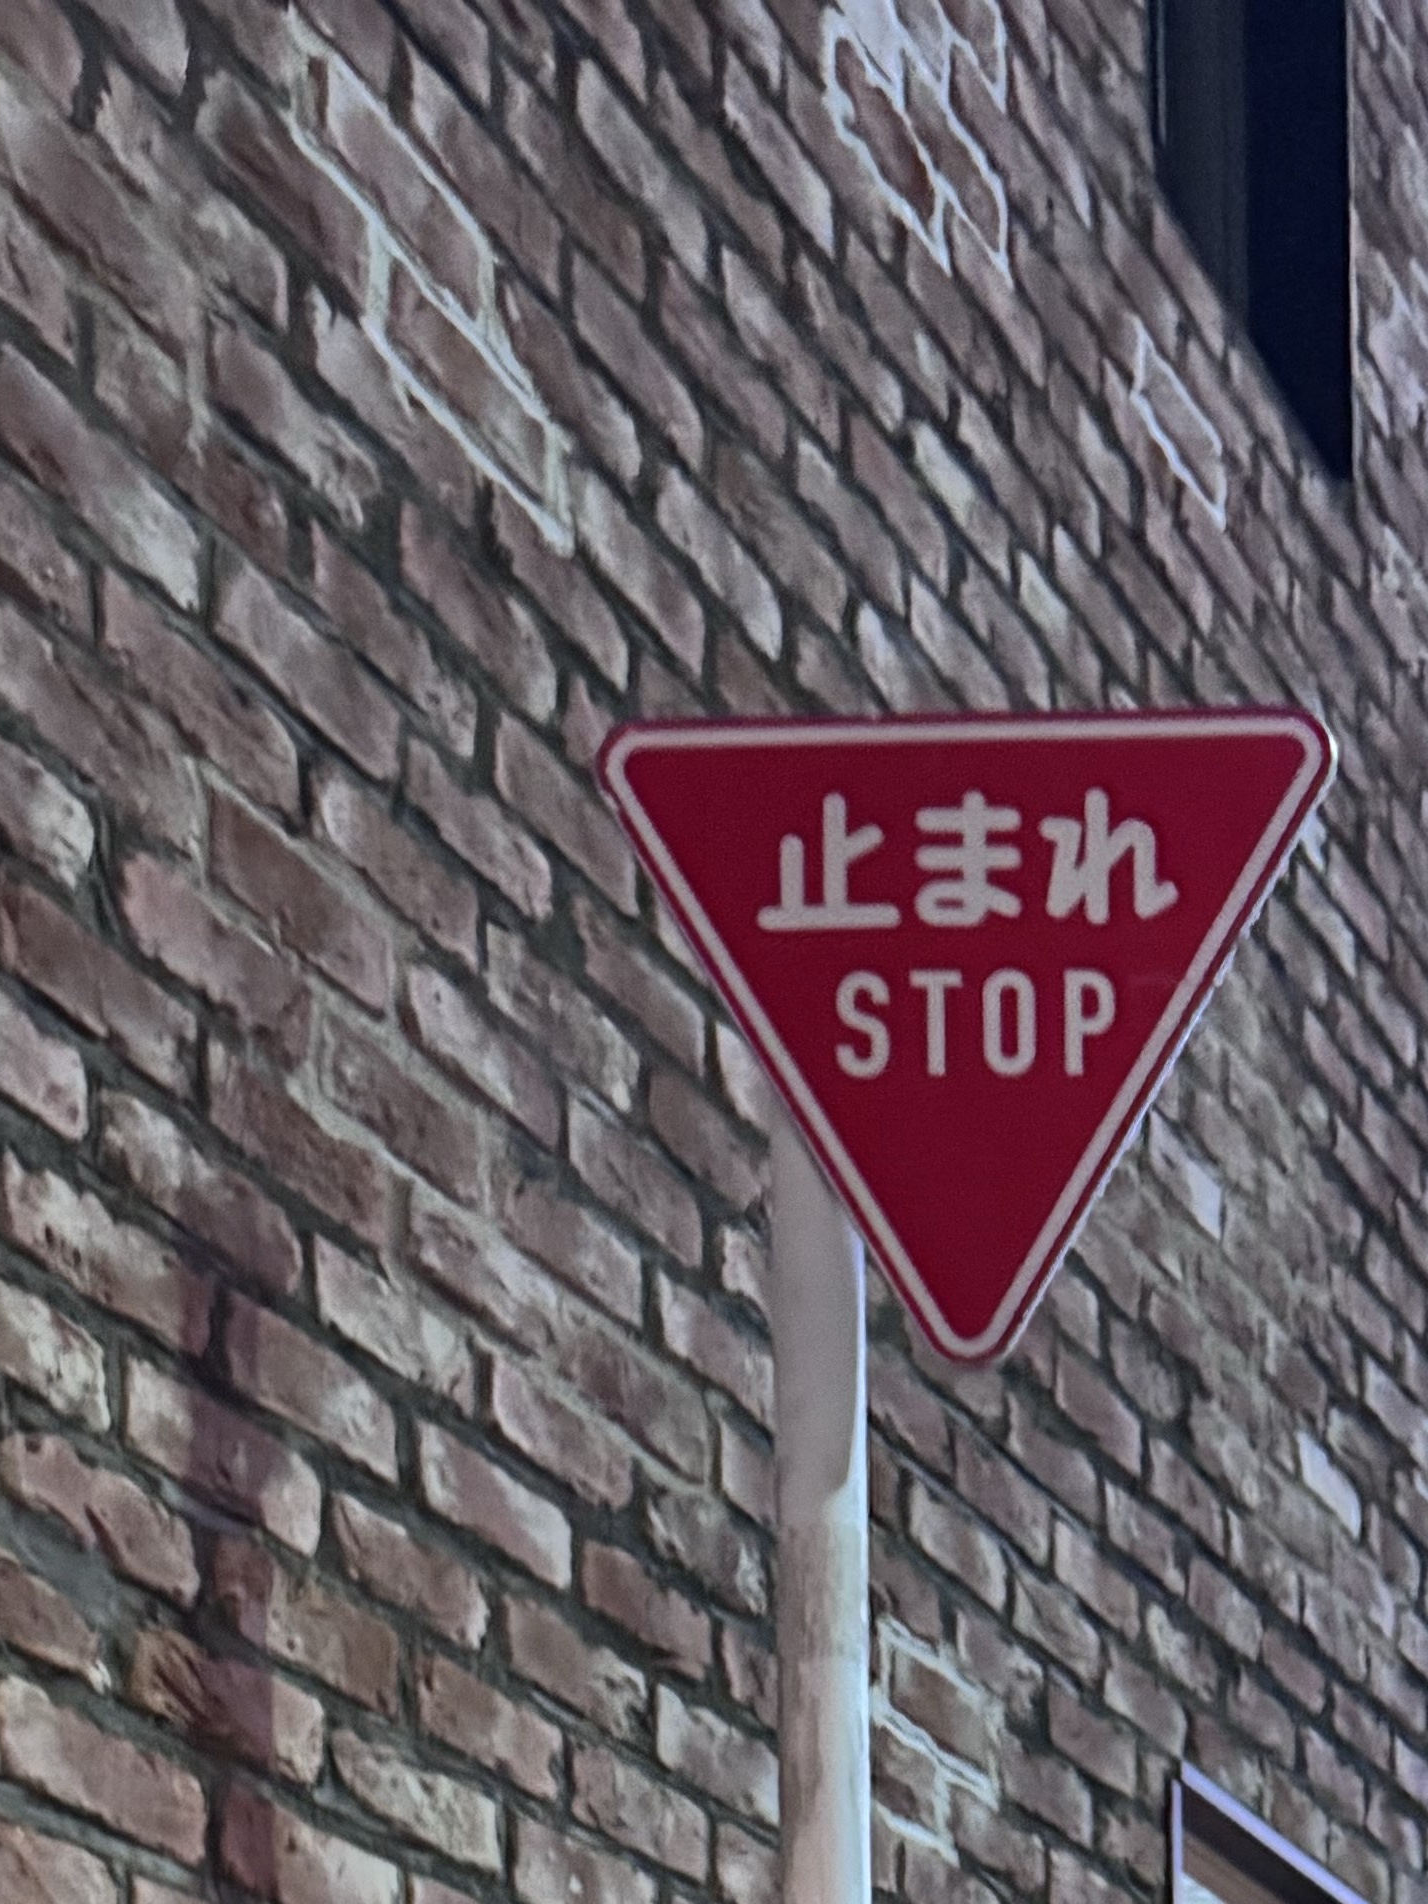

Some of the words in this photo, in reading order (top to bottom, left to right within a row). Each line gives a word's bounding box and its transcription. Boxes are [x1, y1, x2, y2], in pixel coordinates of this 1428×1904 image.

[757, 788, 1179, 931] 止まれ
[834, 968, 1116, 1079] STOP
